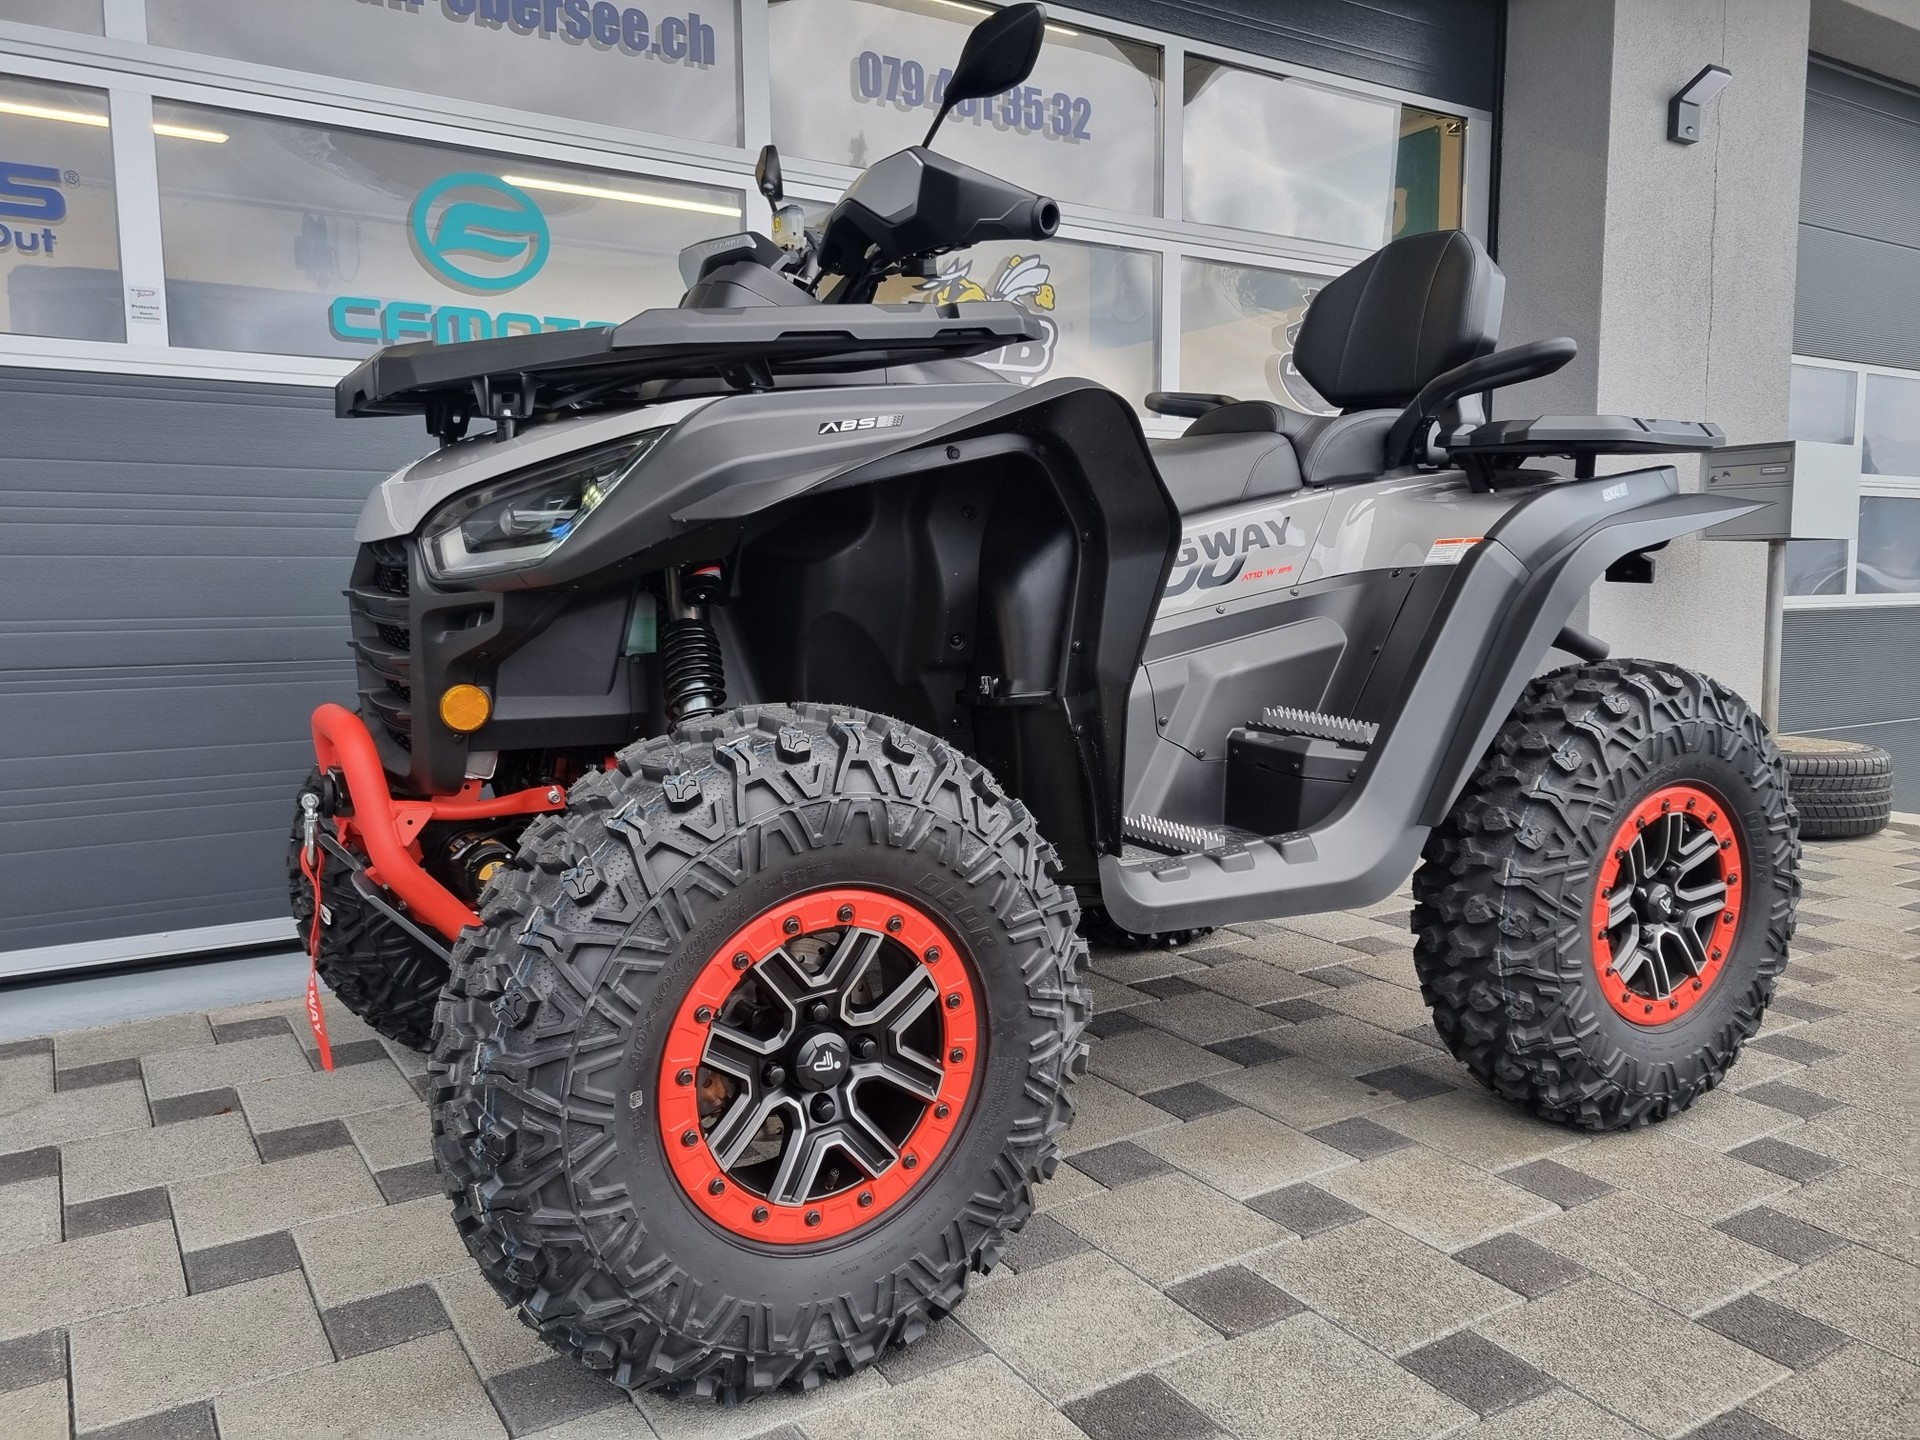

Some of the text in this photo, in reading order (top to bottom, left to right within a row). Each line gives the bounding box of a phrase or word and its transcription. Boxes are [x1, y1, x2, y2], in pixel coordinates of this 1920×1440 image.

[858, 50, 925, 107] 079
[1002, 85, 1044, 131] 35
[1051, 92, 1092, 141] 32
[332, 295, 622, 346] CFMO
[819, 417, 876, 434] ABS
[1241, 571, 1264, 582] AT10
[1266, 567, 1276, 577] W
